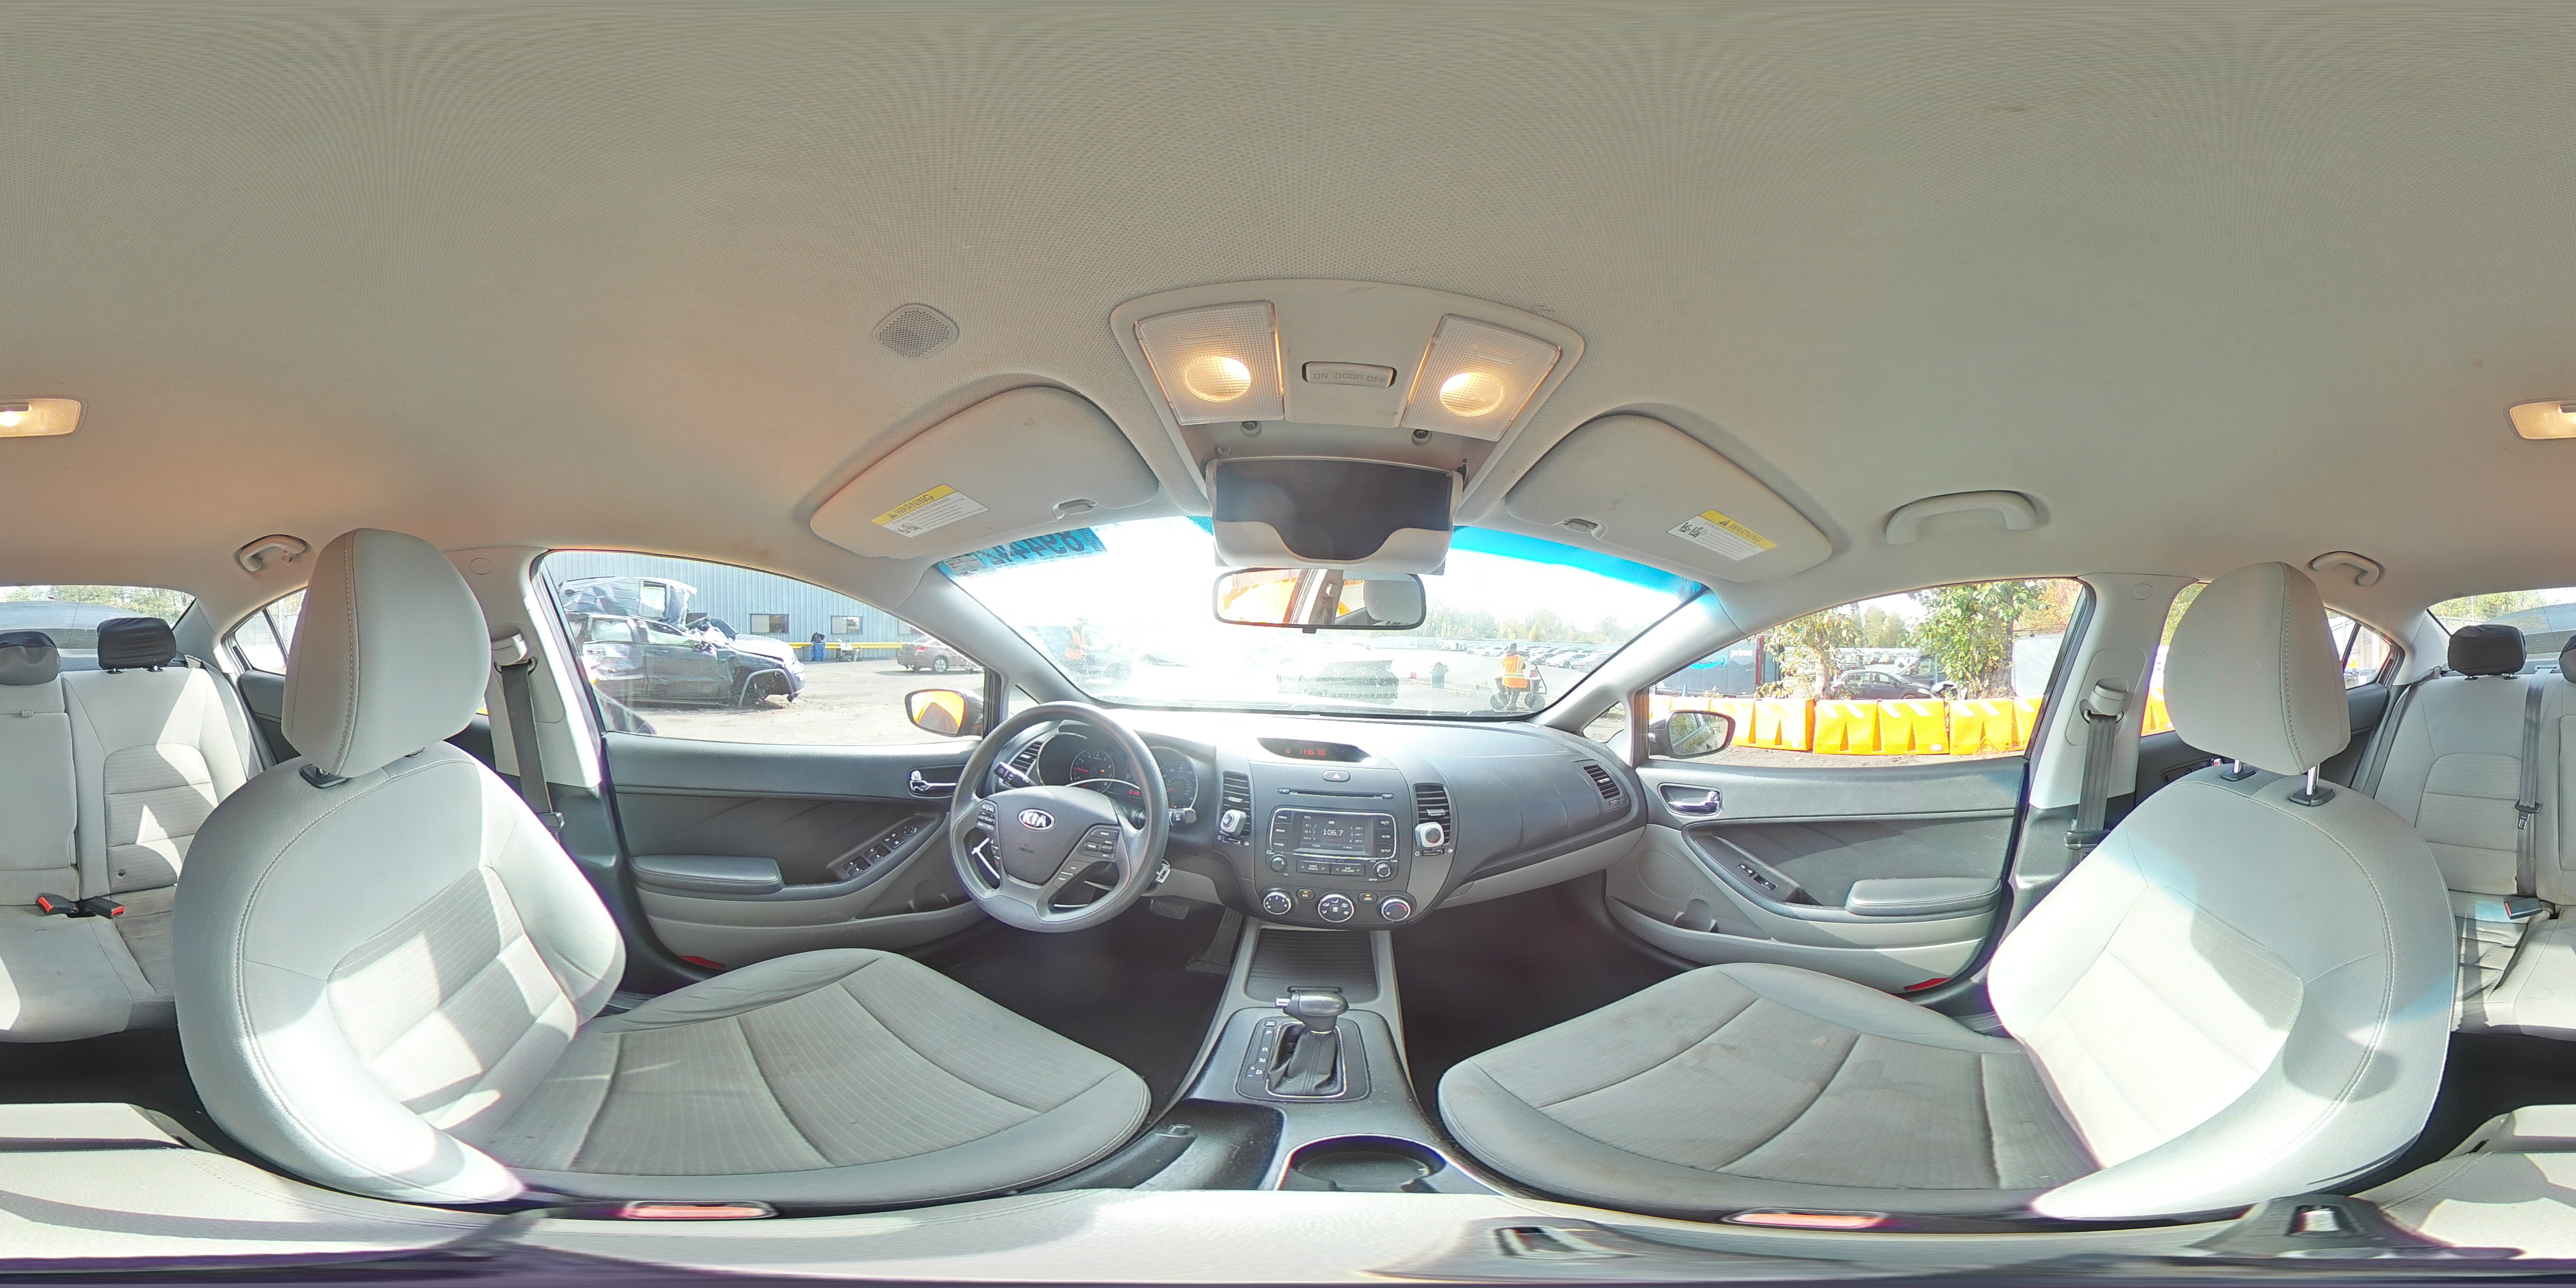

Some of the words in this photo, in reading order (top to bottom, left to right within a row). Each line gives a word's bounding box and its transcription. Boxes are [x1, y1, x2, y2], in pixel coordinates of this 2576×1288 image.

[895, 494, 934, 515] WARNING
[910, 506, 932, 517] ADVANCED
[1728, 523, 1763, 543] WARNING
[1730, 647, 1753, 658] prime
[1023, 811, 1046, 827] KIA
